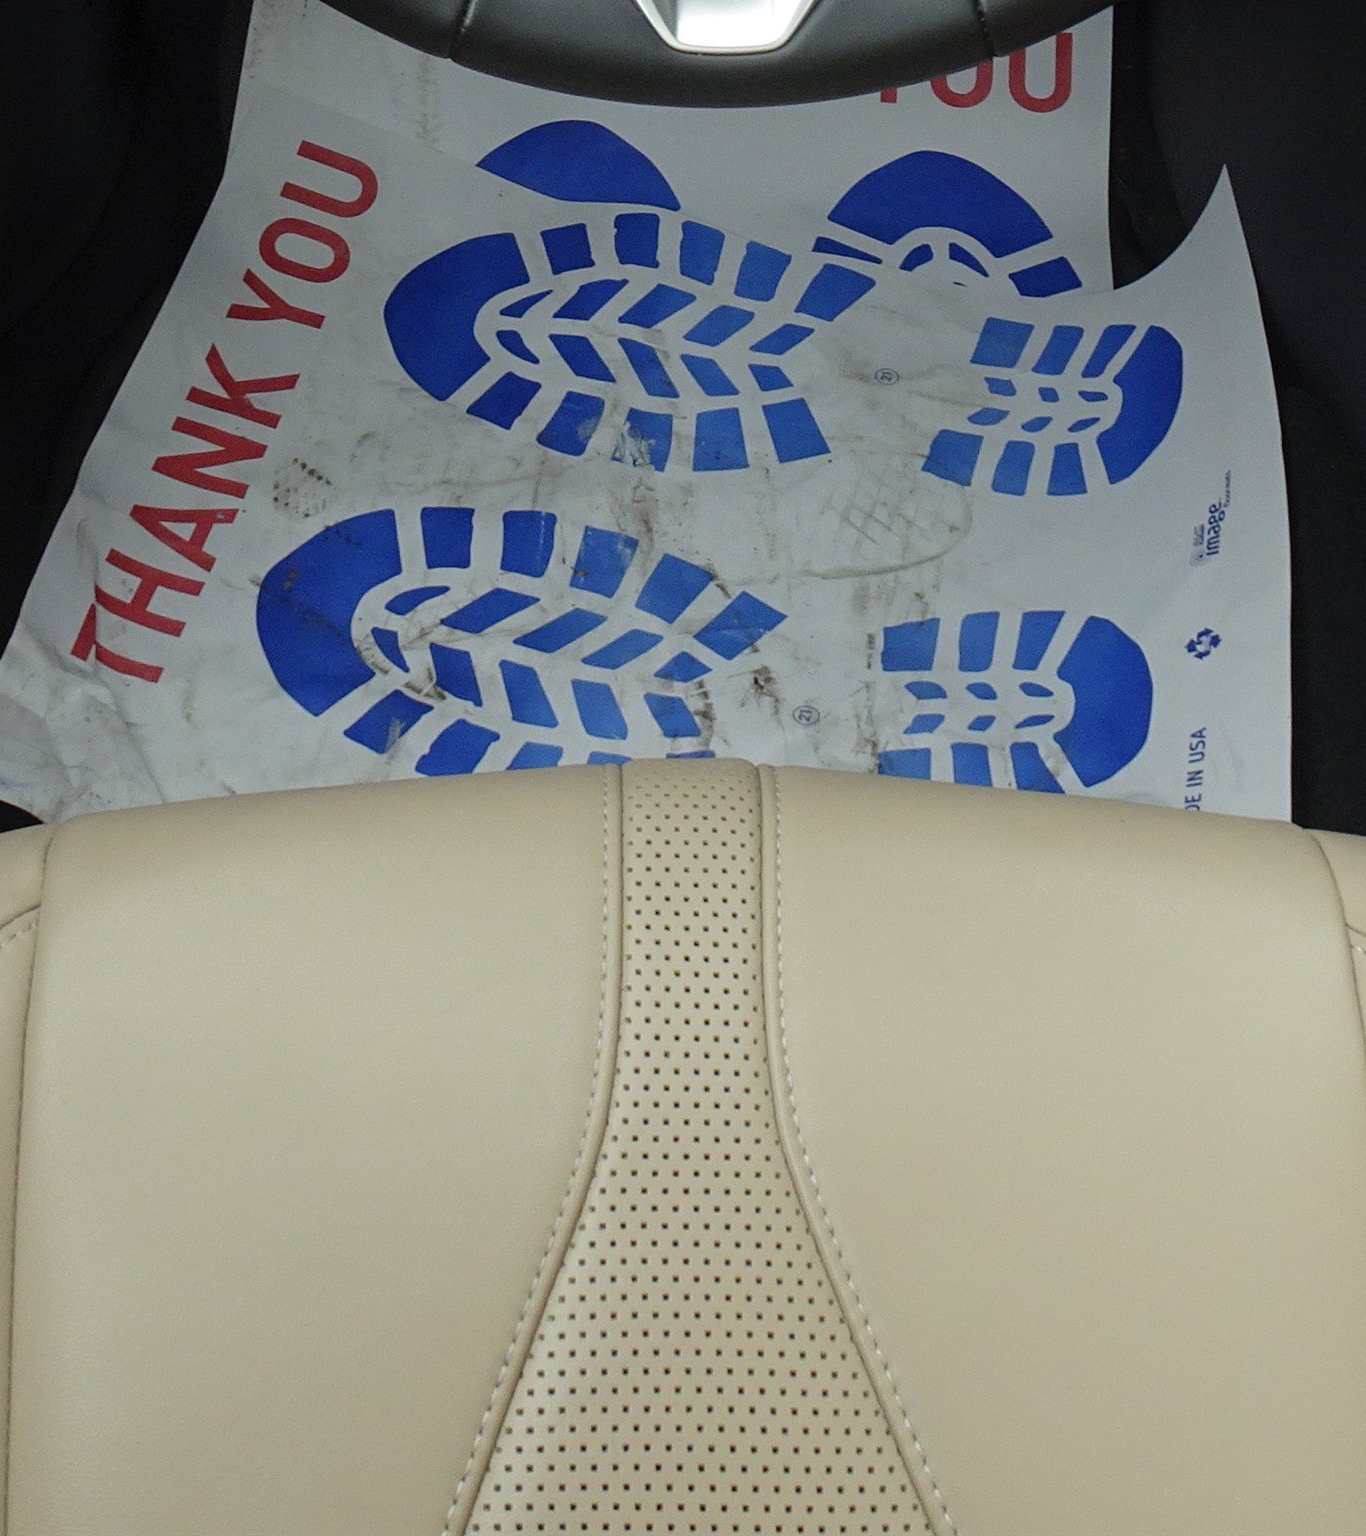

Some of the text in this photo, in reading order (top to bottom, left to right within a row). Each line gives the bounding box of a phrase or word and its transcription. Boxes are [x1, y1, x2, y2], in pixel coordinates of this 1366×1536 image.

[880, 32, 1073, 113] OU
[69, 139, 379, 684] THANK YOU
[1206, 502, 1226, 556] image
[1184, 726, 1207, 811] DE IN USA
